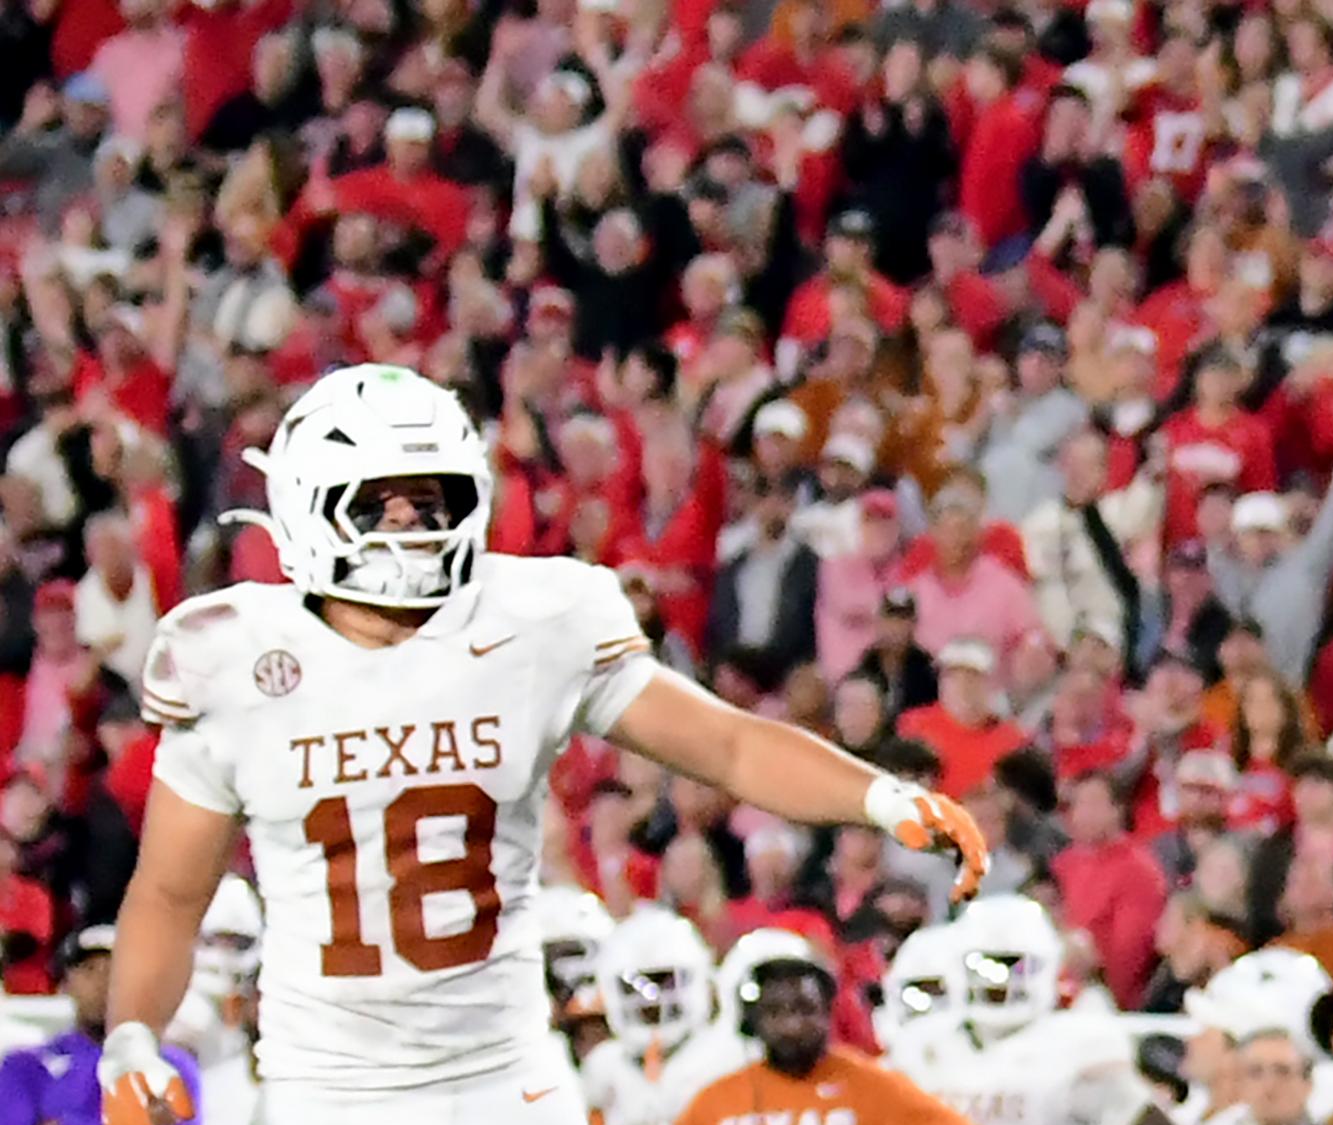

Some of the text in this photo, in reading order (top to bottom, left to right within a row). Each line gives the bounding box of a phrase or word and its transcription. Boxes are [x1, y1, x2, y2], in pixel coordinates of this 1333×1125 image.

[254, 649, 303, 697] SEC
[289, 715, 502, 789] TEXAS
[303, 780, 503, 978] 18
